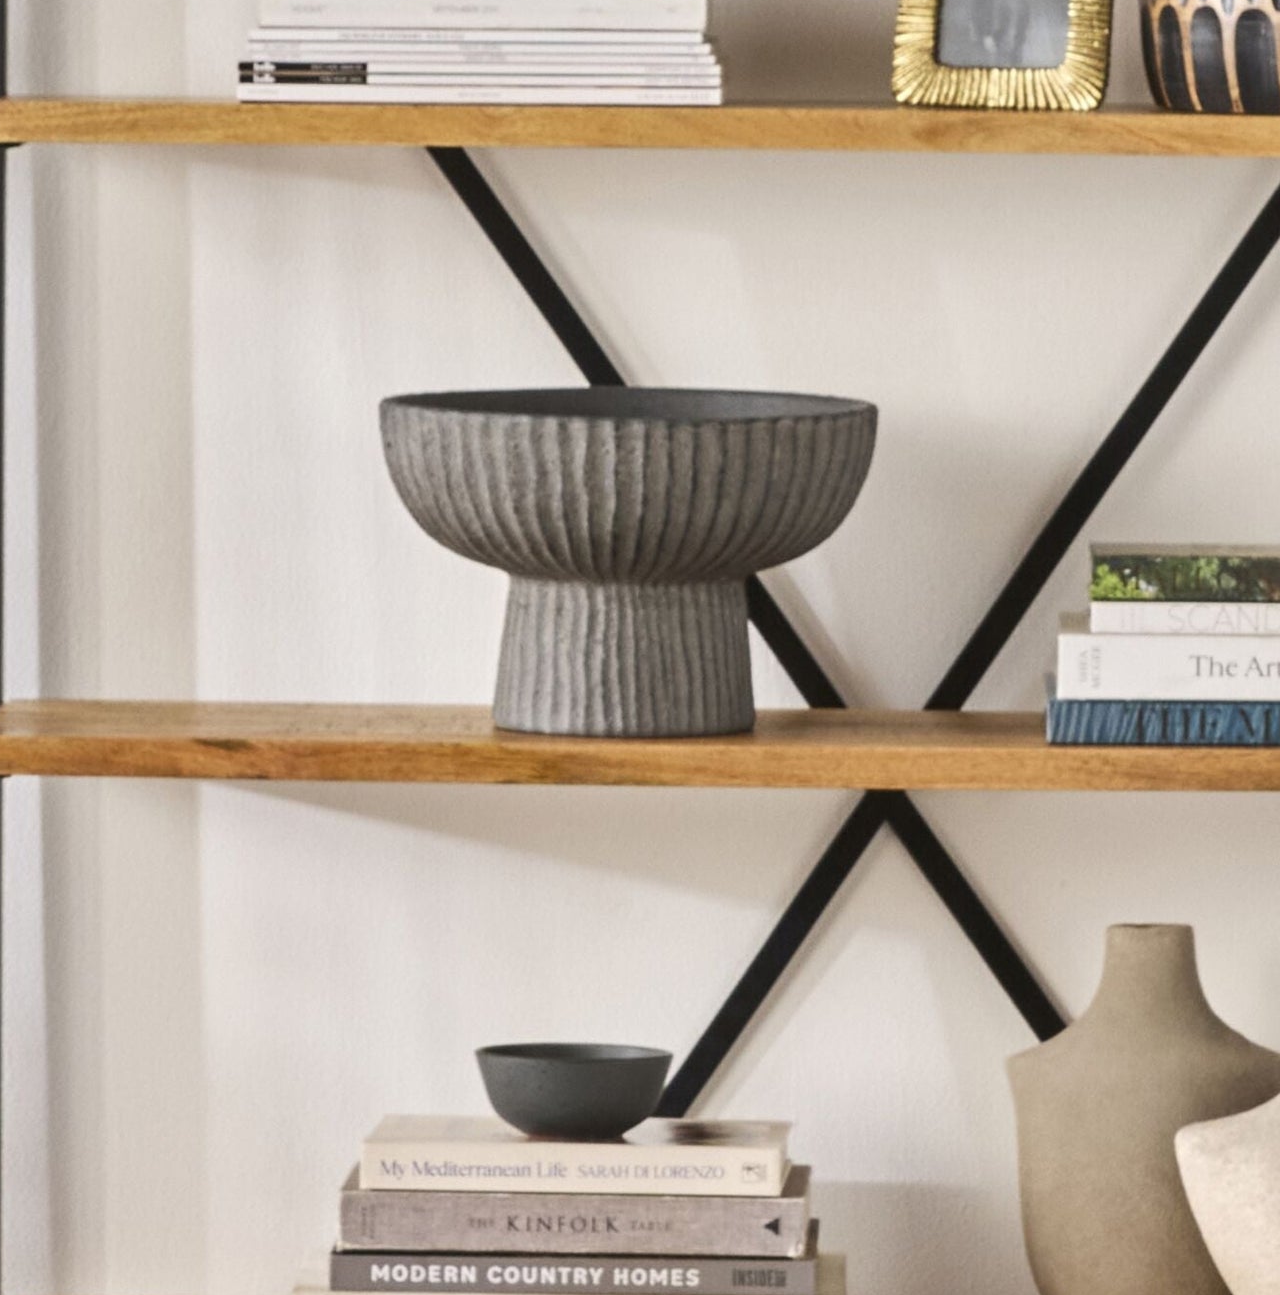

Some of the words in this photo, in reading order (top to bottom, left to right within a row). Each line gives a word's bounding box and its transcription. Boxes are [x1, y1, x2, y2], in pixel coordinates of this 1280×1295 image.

[1189, 655, 1238, 679] The
[379, 1159, 406, 1180] My
[412, 1160, 532, 1179] Mediterranean
[537, 1161, 569, 1179] Life
[577, 1164, 630, 1179] SARAH
[634, 1165, 649, 1179] DI
[652, 1165, 726, 1180] LORENZO
[506, 1215, 620, 1234] KINFOLK
[370, 1264, 477, 1284] MODERN
[486, 1265, 604, 1286] COUNTRY
[613, 1267, 702, 1288] HOMES
